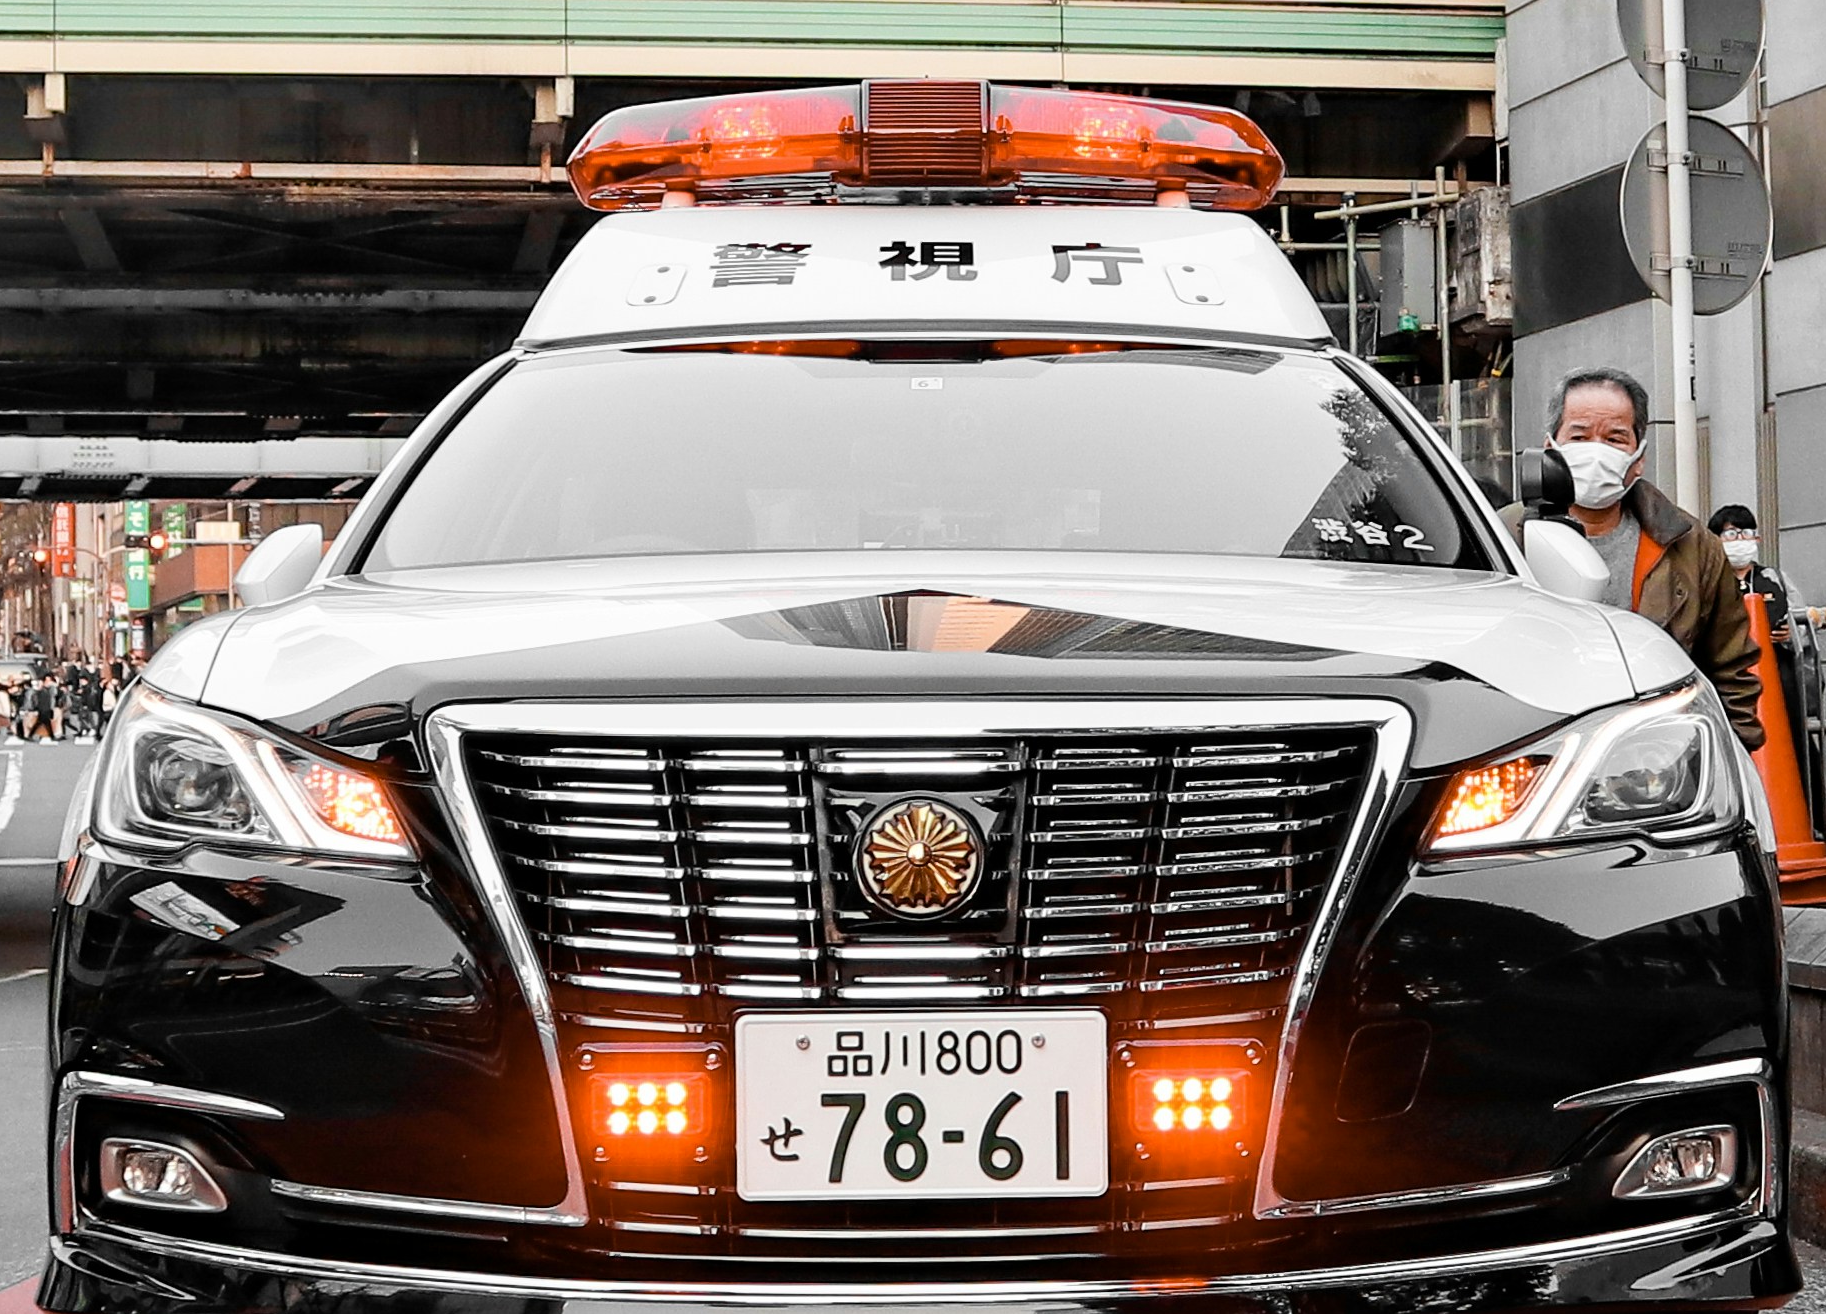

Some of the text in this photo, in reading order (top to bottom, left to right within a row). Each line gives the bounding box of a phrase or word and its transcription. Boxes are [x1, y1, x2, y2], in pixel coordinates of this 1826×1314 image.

[709, 239, 1145, 288] 警視庁
[760, 1090, 1070, 1183] せ 78-61
